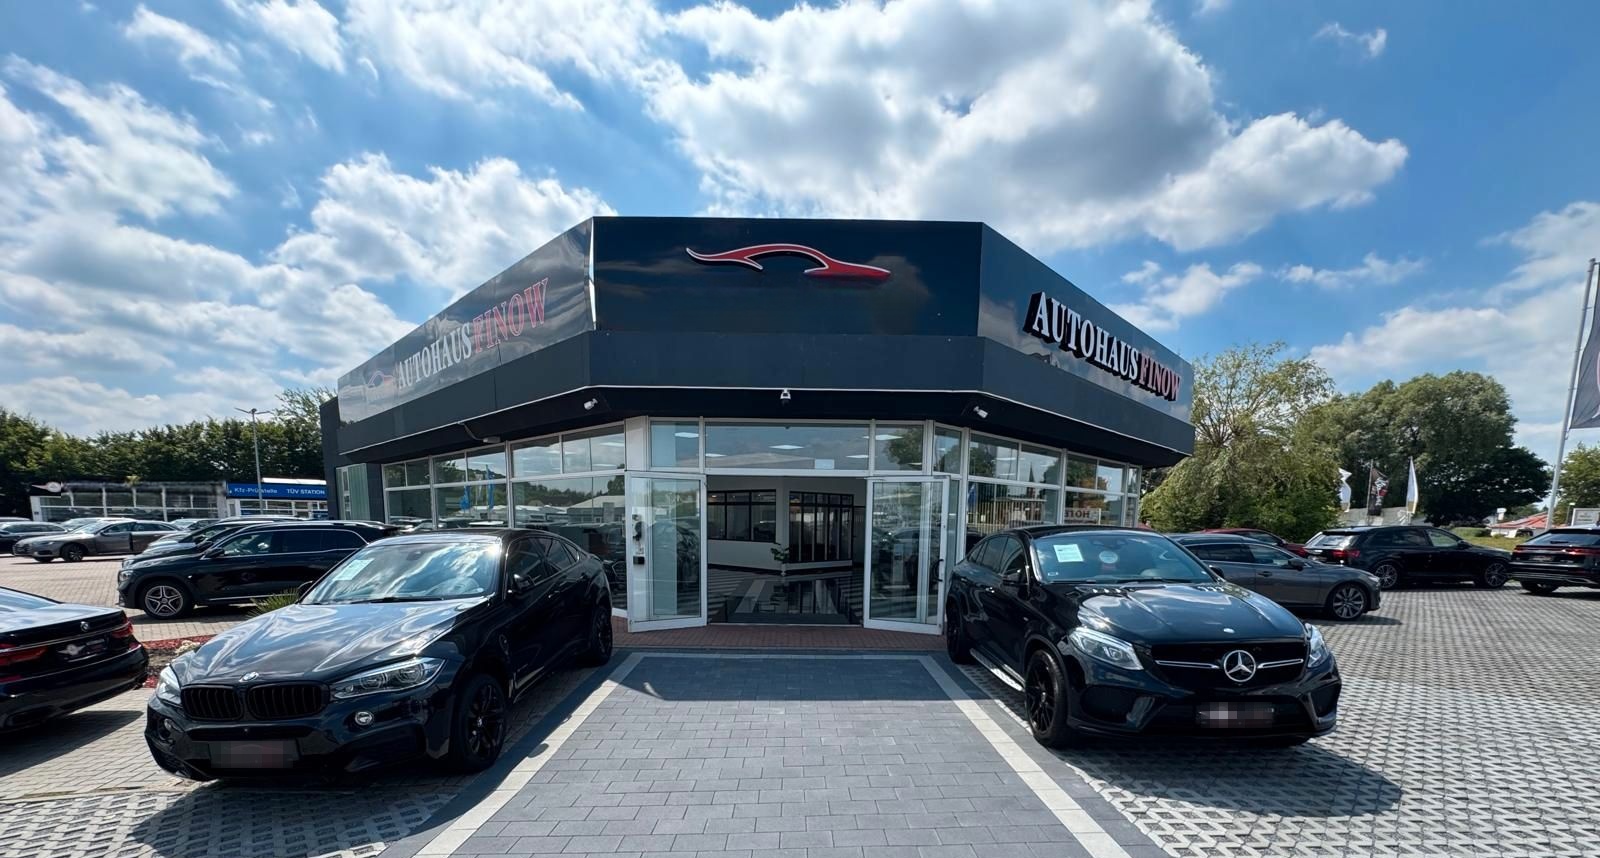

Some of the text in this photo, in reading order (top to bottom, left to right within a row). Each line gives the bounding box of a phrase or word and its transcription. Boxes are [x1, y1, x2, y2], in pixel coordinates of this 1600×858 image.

[398, 276, 550, 391] AUTOHAUS FINOW
[1031, 291, 1183, 401] AUTOHAUS FINOW
[286, 487, 299, 495] TÜV
